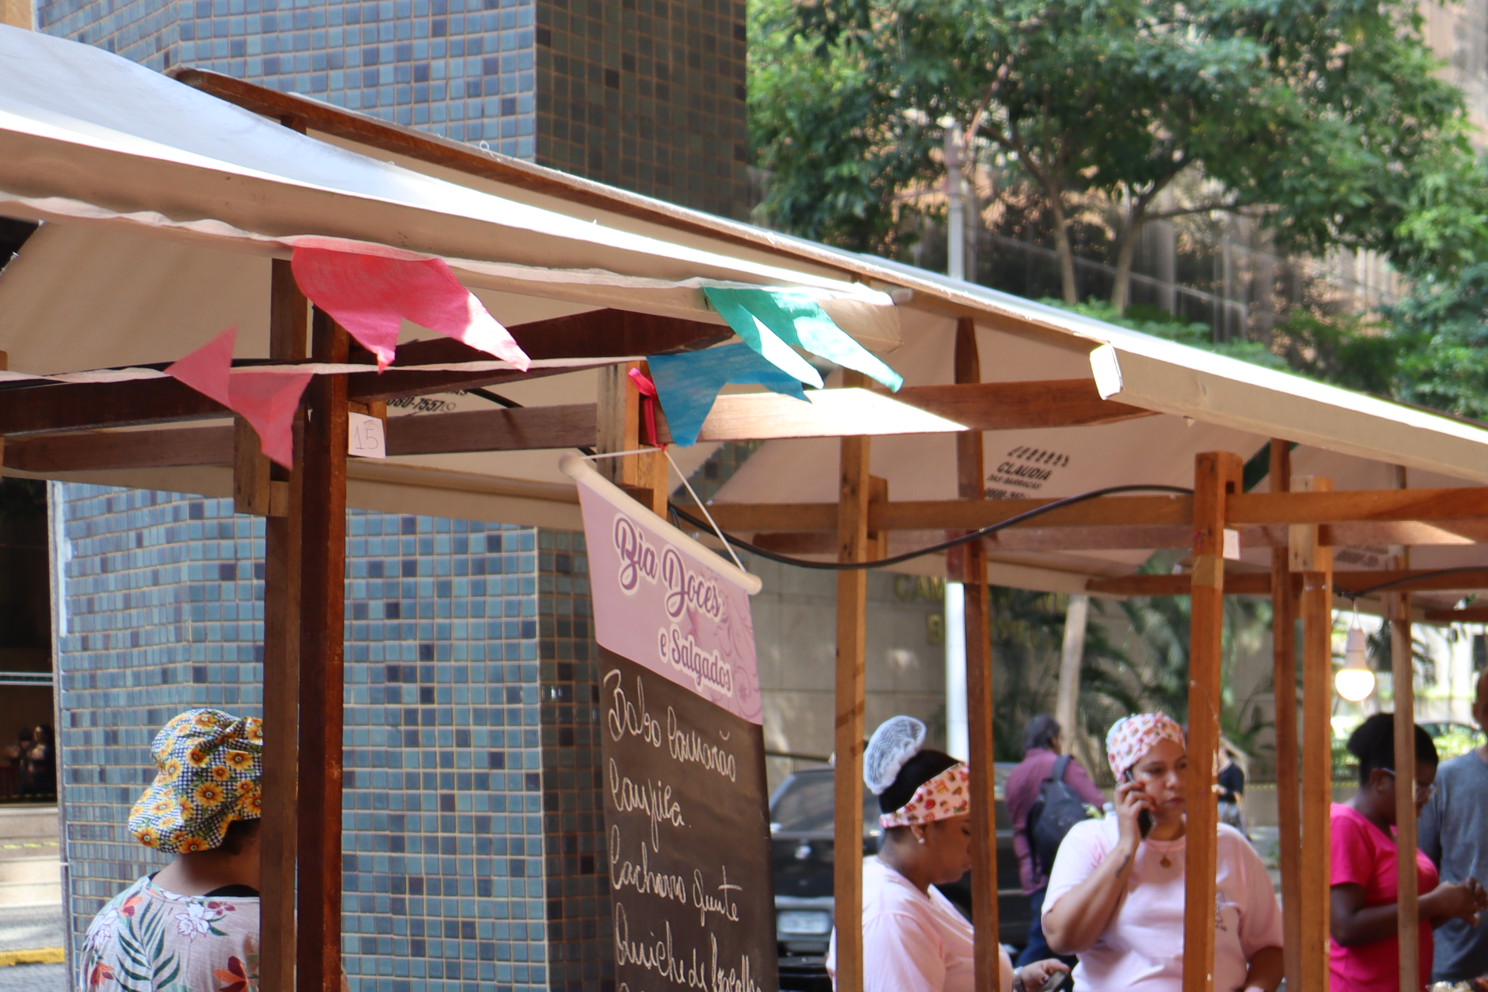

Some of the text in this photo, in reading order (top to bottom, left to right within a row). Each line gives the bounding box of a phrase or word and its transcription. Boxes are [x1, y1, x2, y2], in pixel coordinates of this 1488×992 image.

[996, 461, 1052, 481] CLAUDIA
[614, 516, 721, 619] Bia Doces
[659, 628, 732, 688] e Salgados
